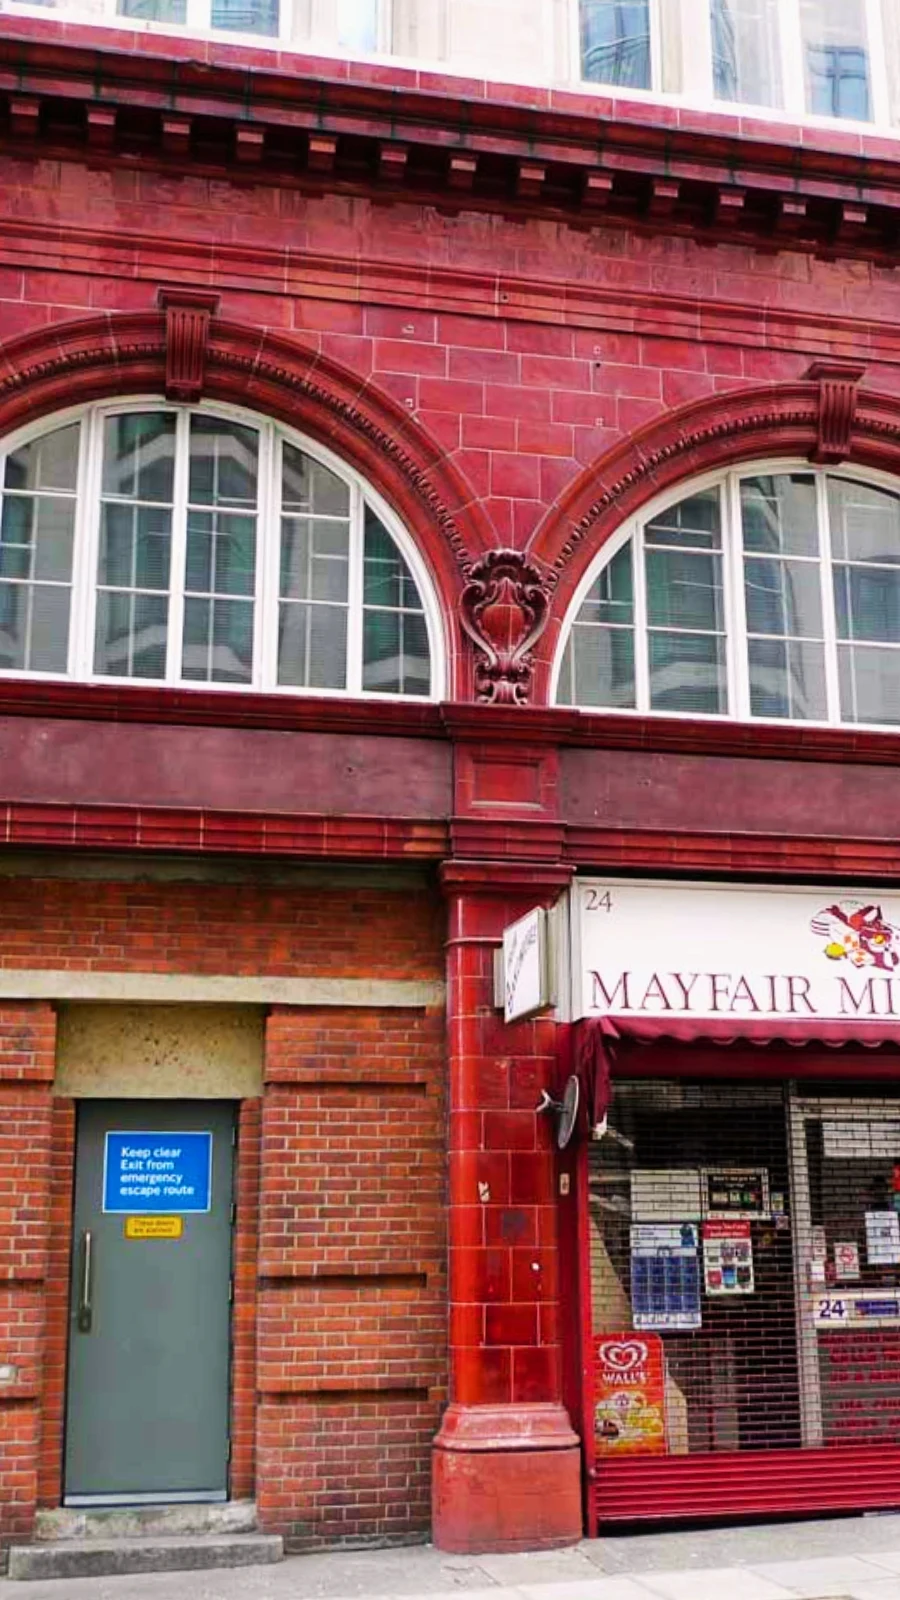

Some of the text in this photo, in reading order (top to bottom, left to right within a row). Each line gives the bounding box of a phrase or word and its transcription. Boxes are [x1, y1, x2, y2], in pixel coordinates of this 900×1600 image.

[585, 889, 613, 913] 24
[587, 970, 900, 1015] MAYFAIR MI
[120, 1146, 182, 1159] Keep clear
[120, 1159, 175, 1170] Exit from
[120, 1173, 183, 1185] emergency
[120, 1186, 195, 1197] escape route
[819, 1299, 845, 1318] 24
[602, 1371, 648, 1385] WALL'S
